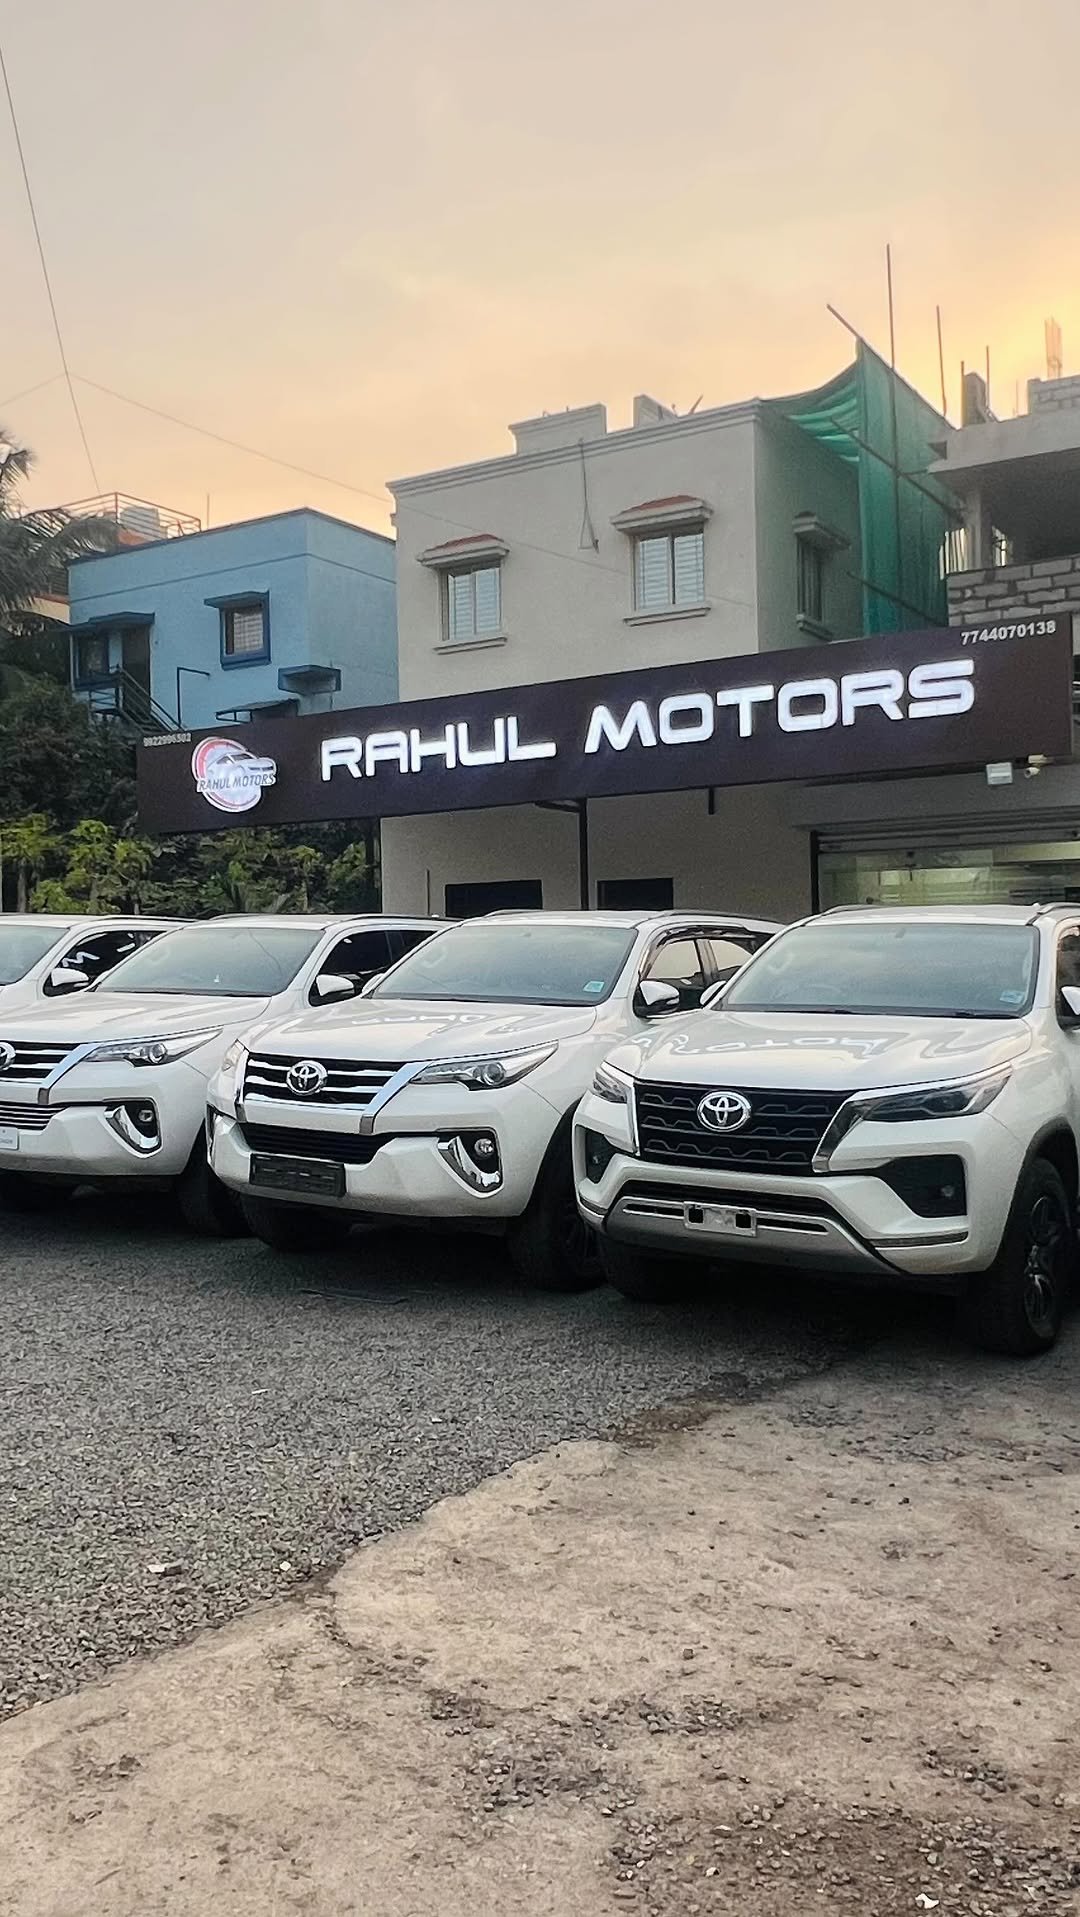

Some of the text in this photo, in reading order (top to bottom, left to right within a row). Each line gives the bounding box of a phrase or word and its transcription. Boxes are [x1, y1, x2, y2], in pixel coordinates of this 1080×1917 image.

[961, 620, 1056, 645] 7744070138
[321, 659, 975, 781] RAHUL MOTORS
[199, 774, 275, 790] RAHUL MOTORS
